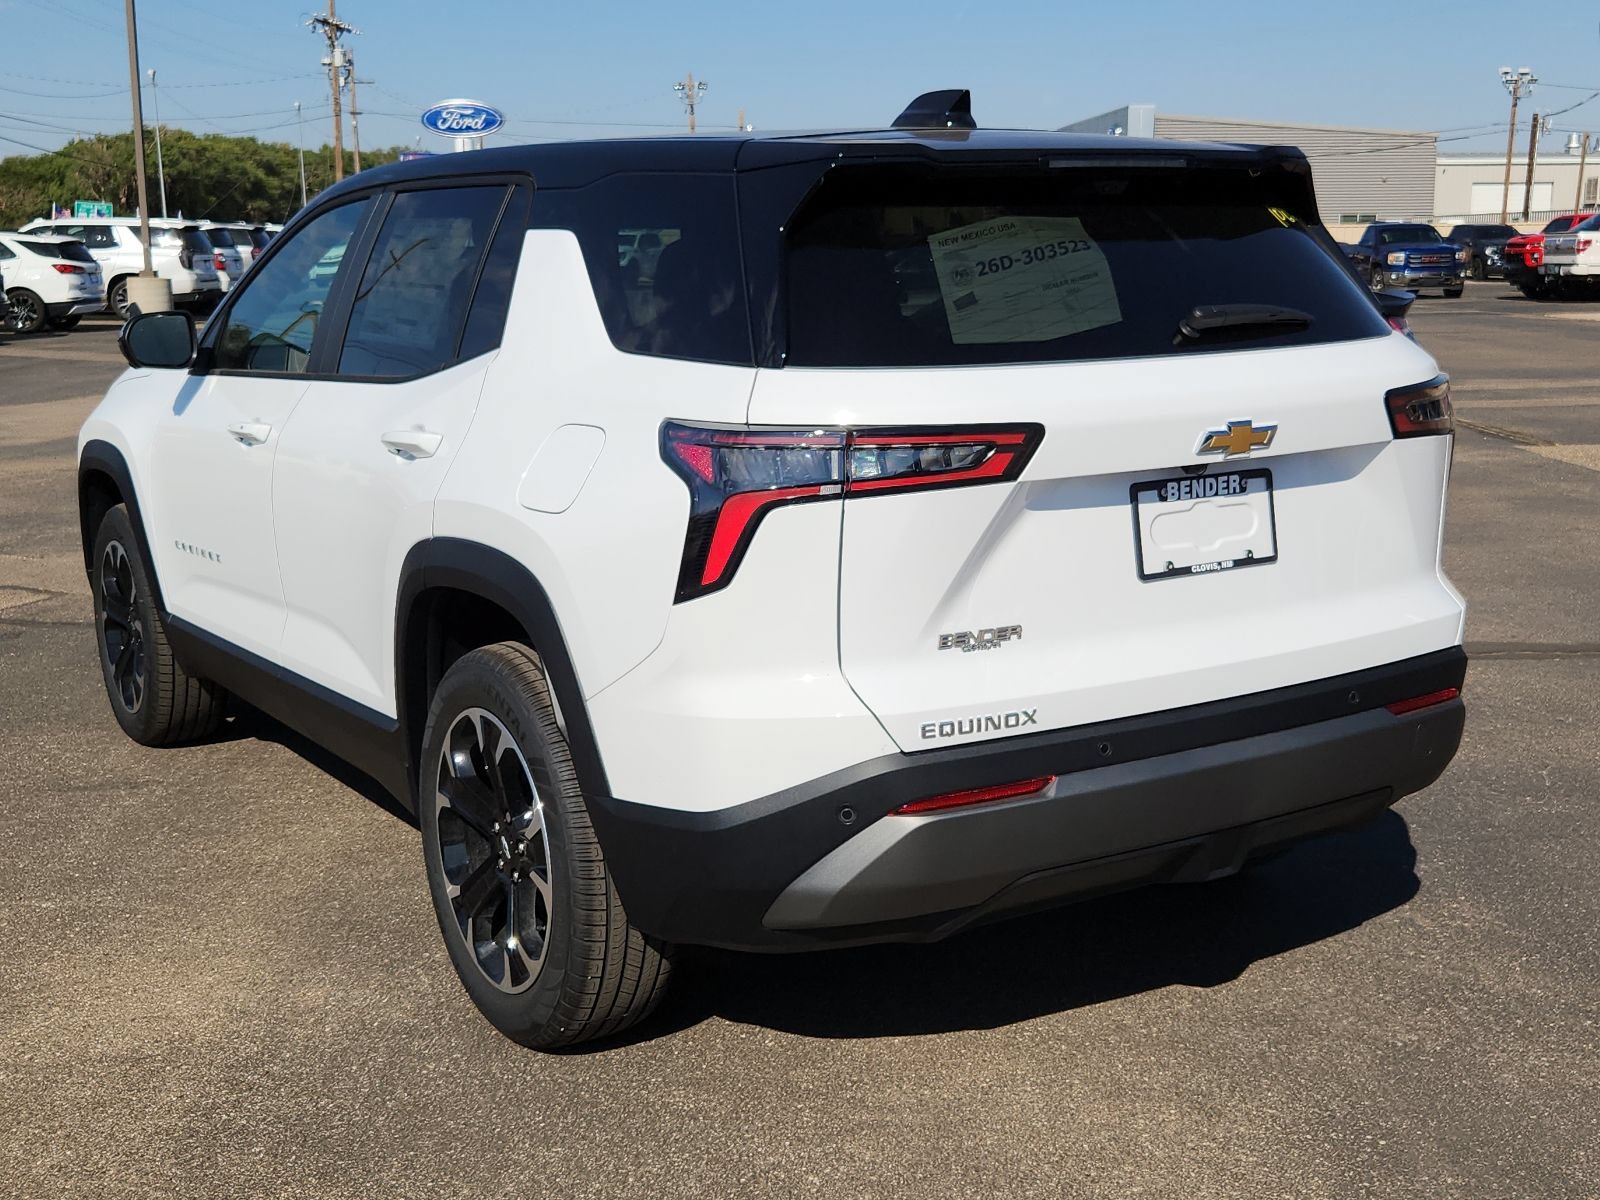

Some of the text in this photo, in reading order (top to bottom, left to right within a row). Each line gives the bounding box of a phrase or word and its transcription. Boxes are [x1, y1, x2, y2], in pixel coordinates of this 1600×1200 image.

[437, 108, 487, 130] Ford
[938, 222, 1017, 248] NEW MEXICO USA
[975, 239, 1092, 277] 26D-303523
[1166, 475, 1241, 501] BENDER
[1191, 560, 1234, 573] CLOVIS, NM
[938, 625, 1023, 650] BENDER
[921, 708, 1038, 739] EQUINOX
